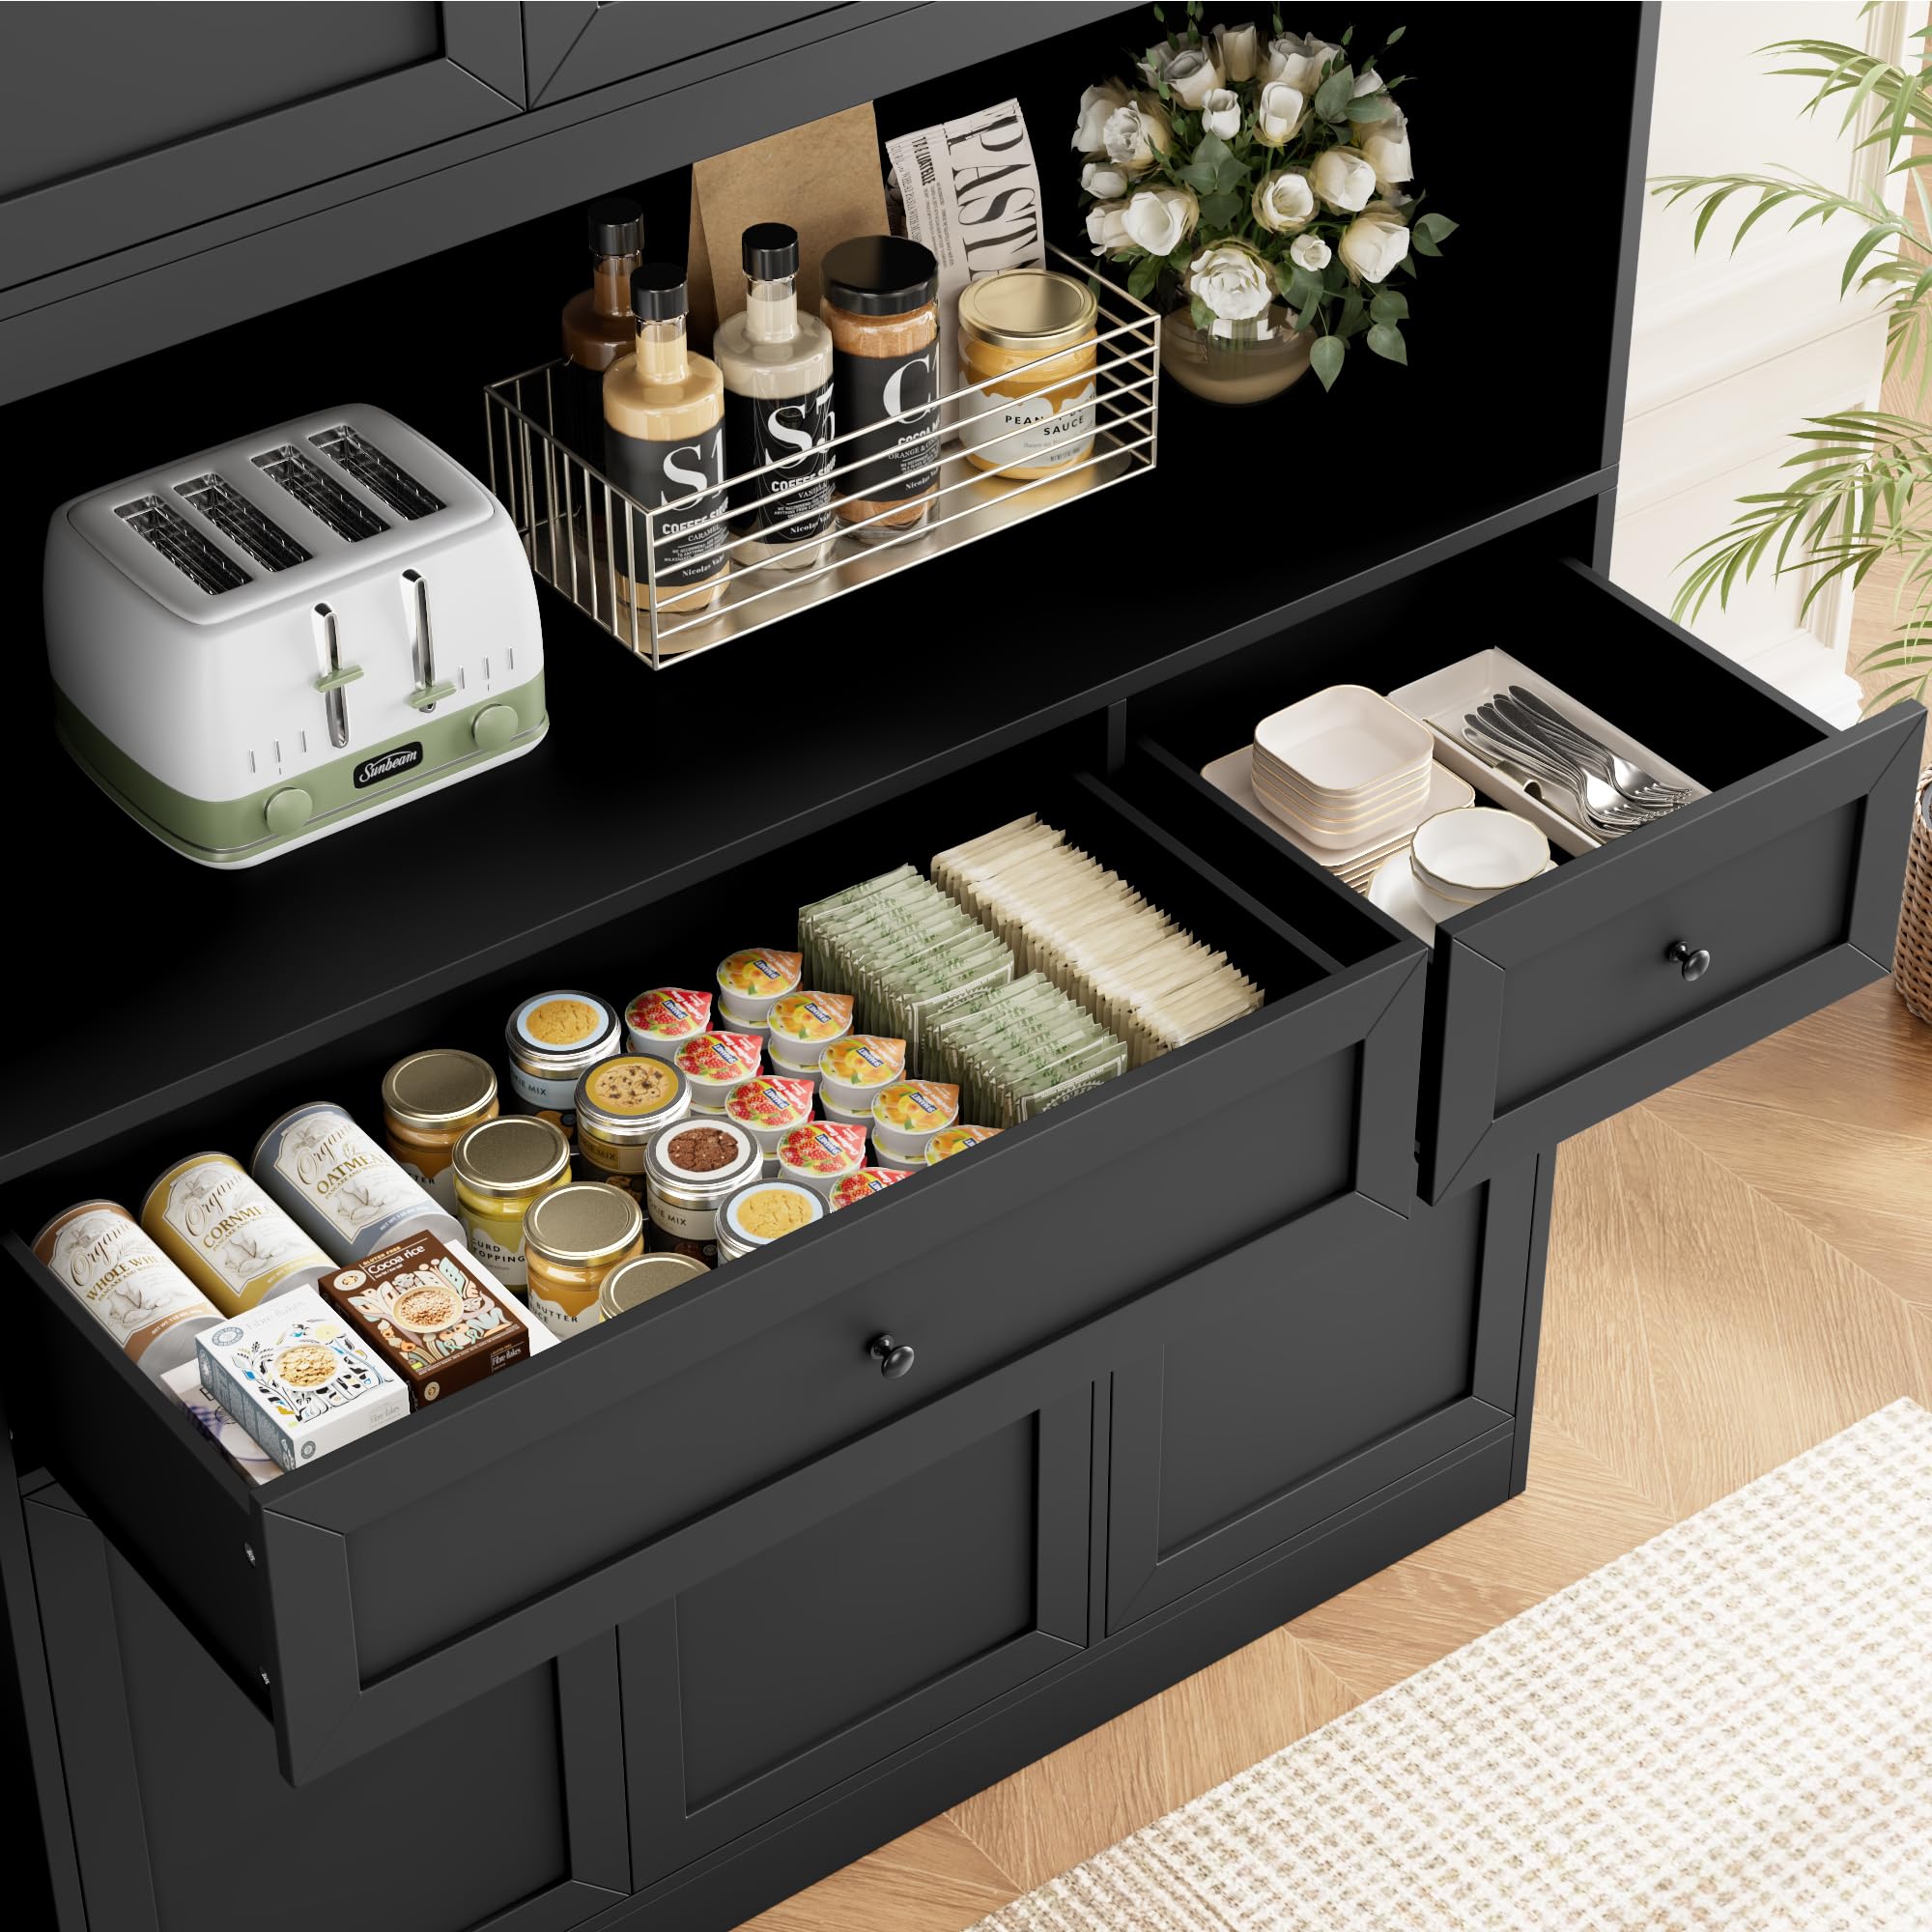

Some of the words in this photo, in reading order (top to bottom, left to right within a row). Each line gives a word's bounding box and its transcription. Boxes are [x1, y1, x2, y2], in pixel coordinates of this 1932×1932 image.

[1043, 415, 1084, 436] SAUCE
[888, 447, 920, 460] ORANGE
[688, 524, 721, 542] CARAMEL
[682, 565, 711, 578] Nicolas
[358, 751, 417, 783] Sunbeam
[528, 1085, 547, 1096] MIX
[597, 1150, 616, 1160] MIX
[203, 1205, 275, 1248] CORNM
[668, 1214, 687, 1226] MIX
[471, 1236, 500, 1253] CURD
[362, 1252, 385, 1265] GLUTEN
[386, 1245, 402, 1257] FREE
[367, 1256, 405, 1275] Cocoa
[404, 1244, 426, 1260] rice
[473, 1247, 526, 1263] TOPPING
[86, 1262, 130, 1301] WHOLE
[536, 1301, 579, 1322] BUTTER
